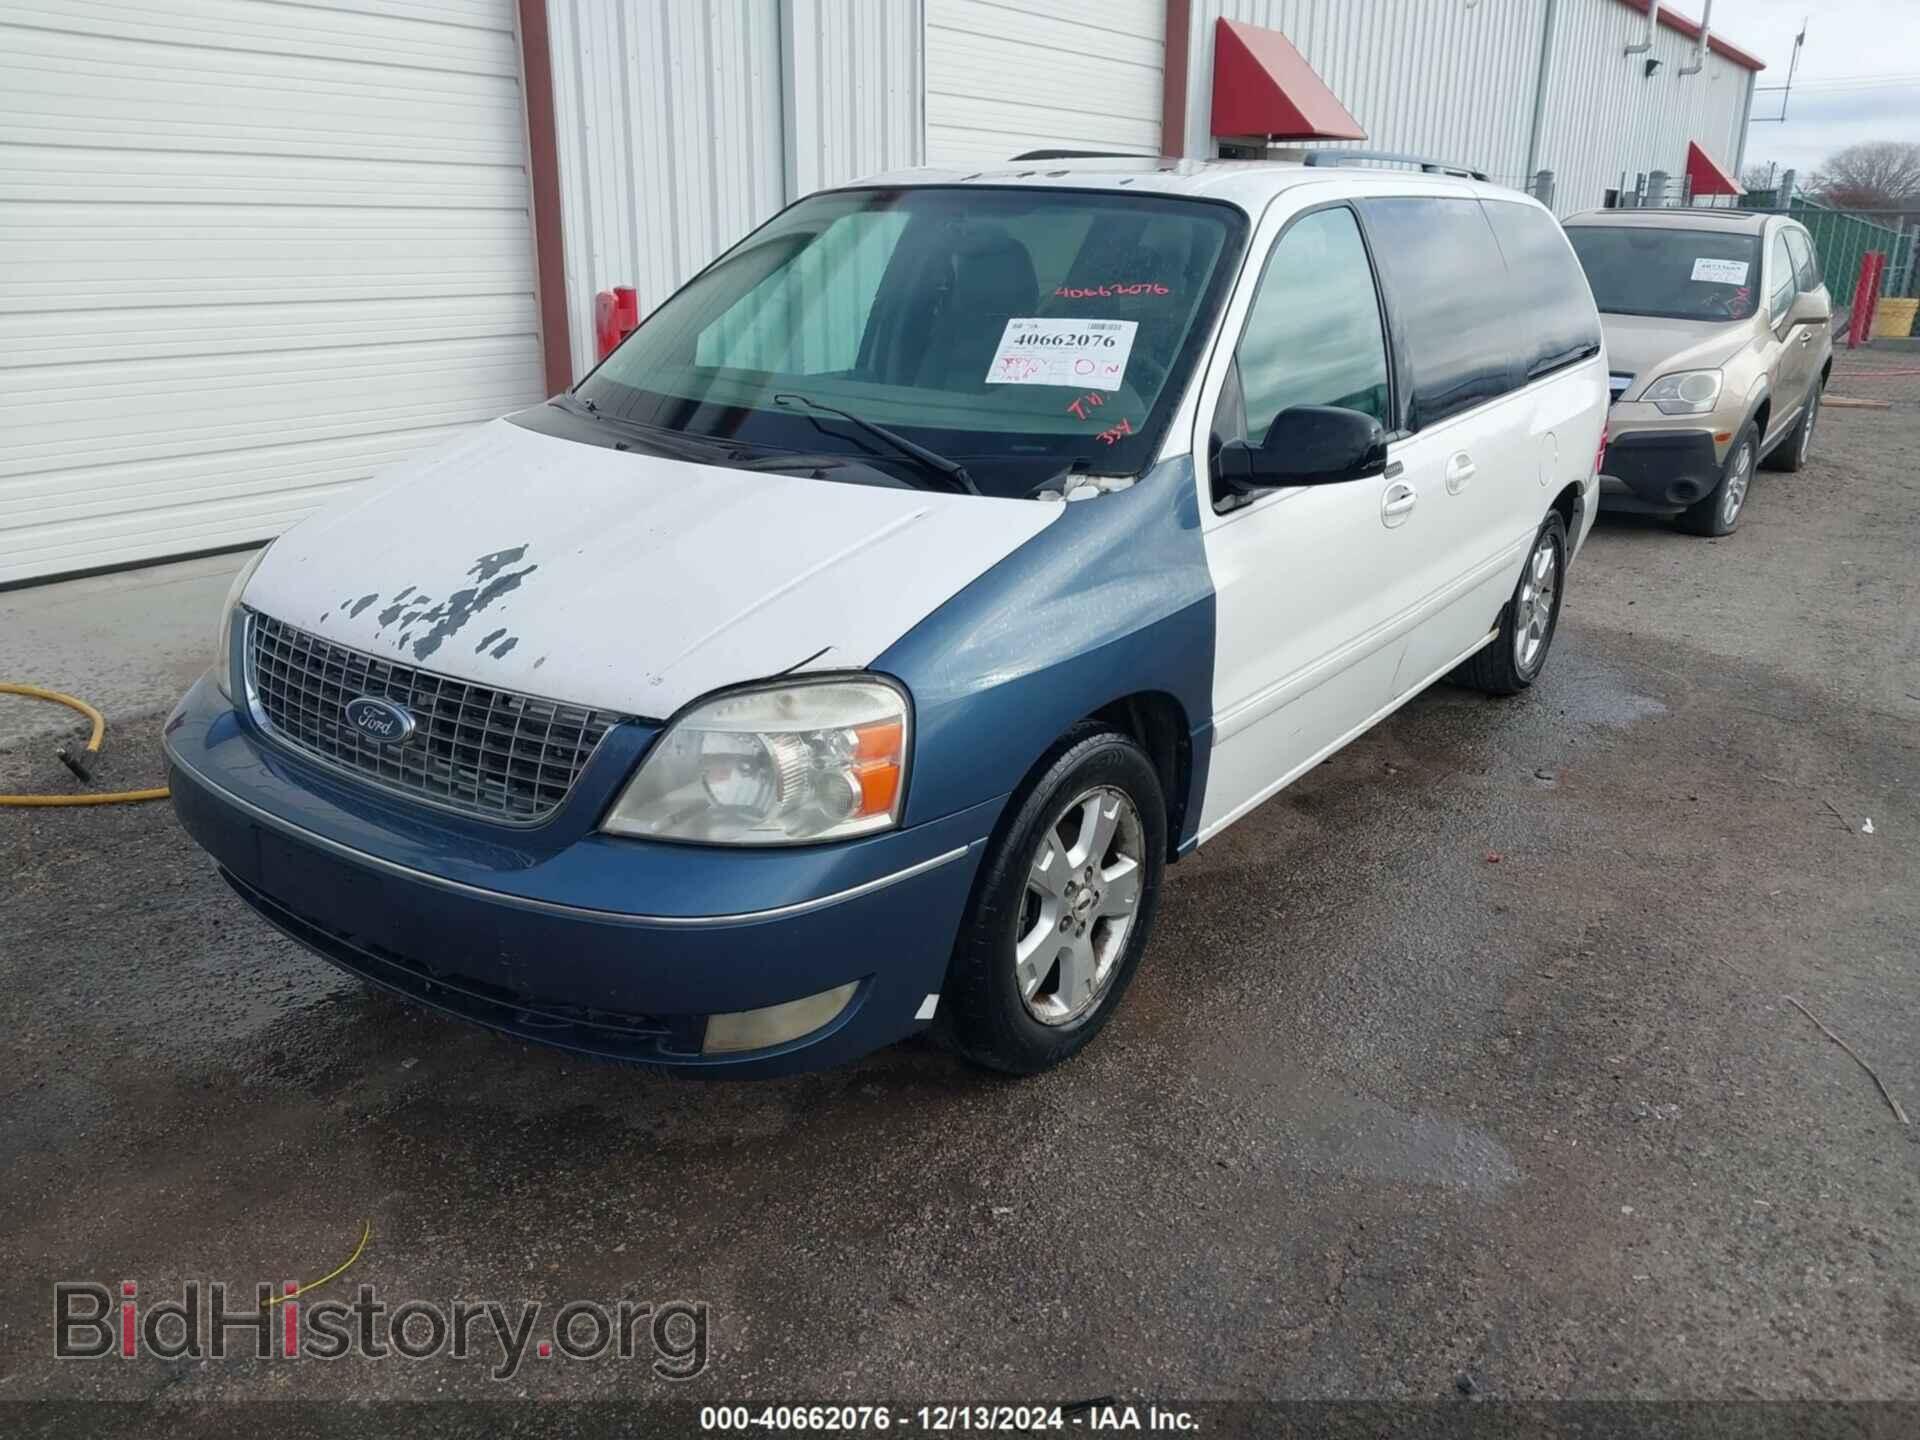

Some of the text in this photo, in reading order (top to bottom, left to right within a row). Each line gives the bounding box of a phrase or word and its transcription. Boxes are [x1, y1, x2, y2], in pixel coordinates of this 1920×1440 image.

[1055, 283, 1169, 298] 40662076
[1013, 333, 1116, 348] 40662076
[358, 705, 394, 736] Ford
